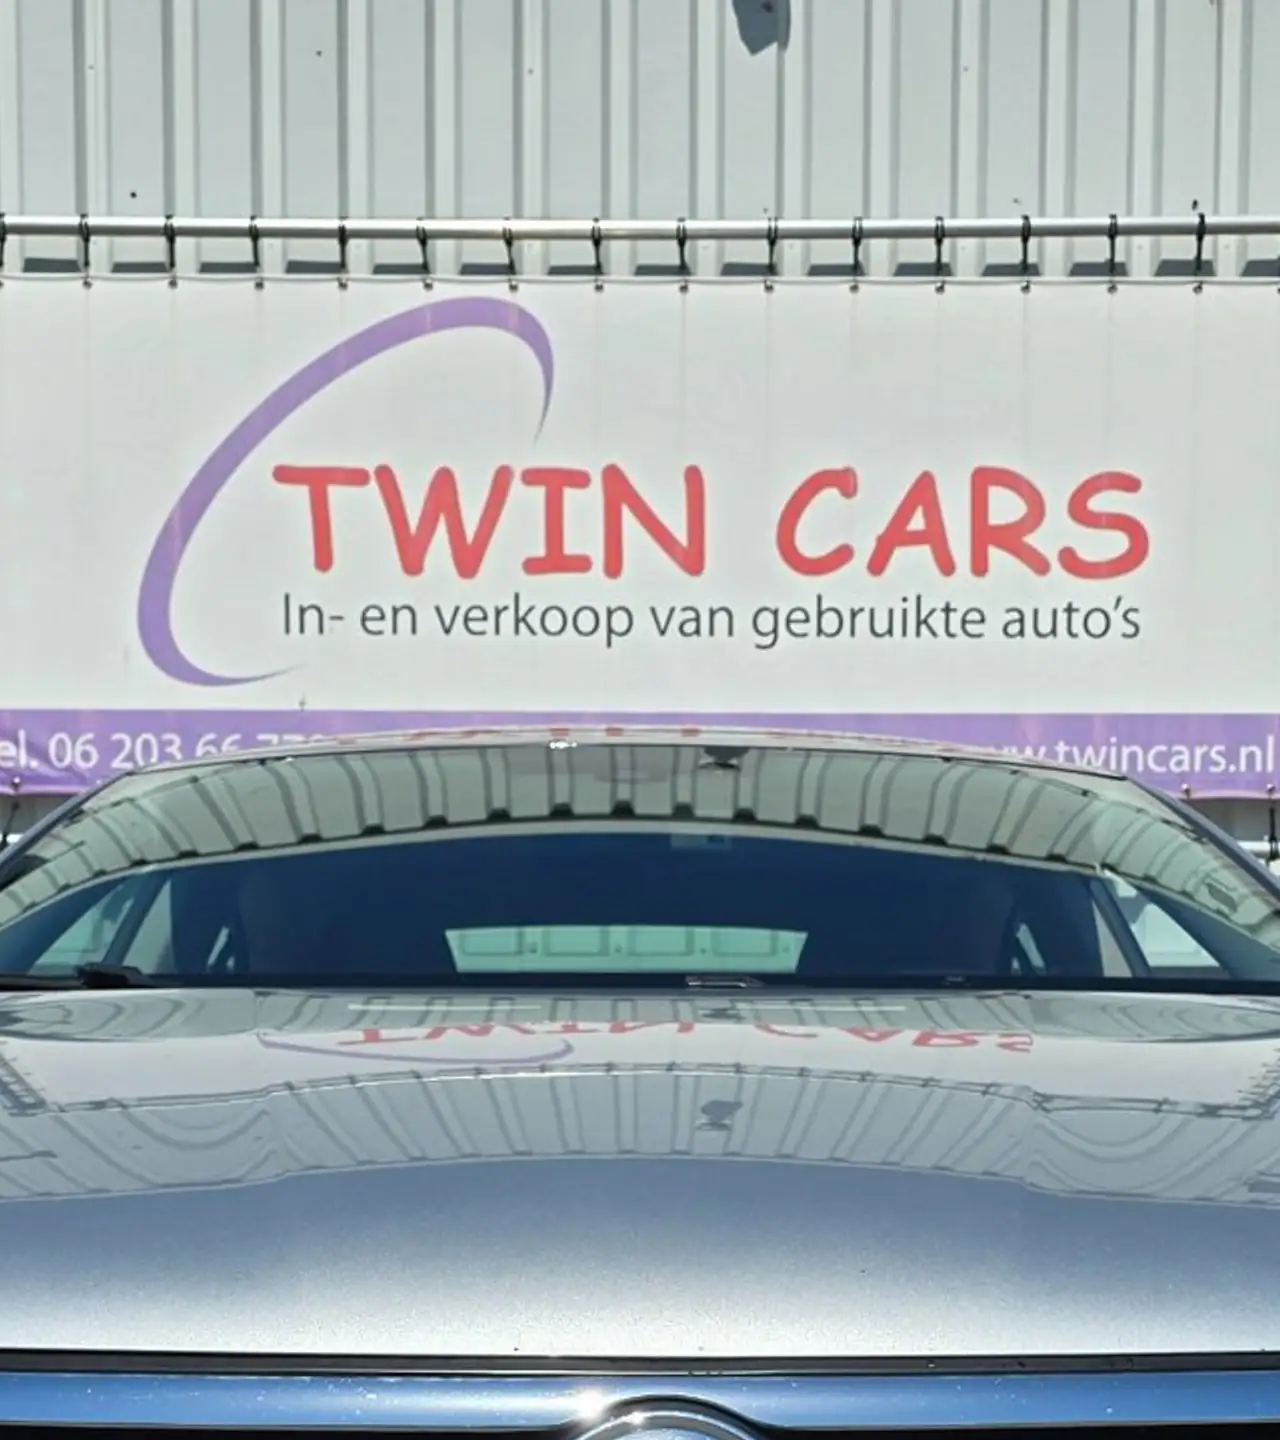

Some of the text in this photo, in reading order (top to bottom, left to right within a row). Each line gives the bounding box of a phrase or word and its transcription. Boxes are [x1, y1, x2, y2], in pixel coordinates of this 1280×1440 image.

[271, 463, 1150, 581] TWIN CARS
[283, 592, 345, 637] In-
[358, 604, 418, 637] en
[433, 591, 635, 649] verkoop
[648, 605, 735, 639] van
[750, 593, 988, 650] gebruikte
[47, 732, 100, 769] 06
[110, 732, 183, 770] 203
